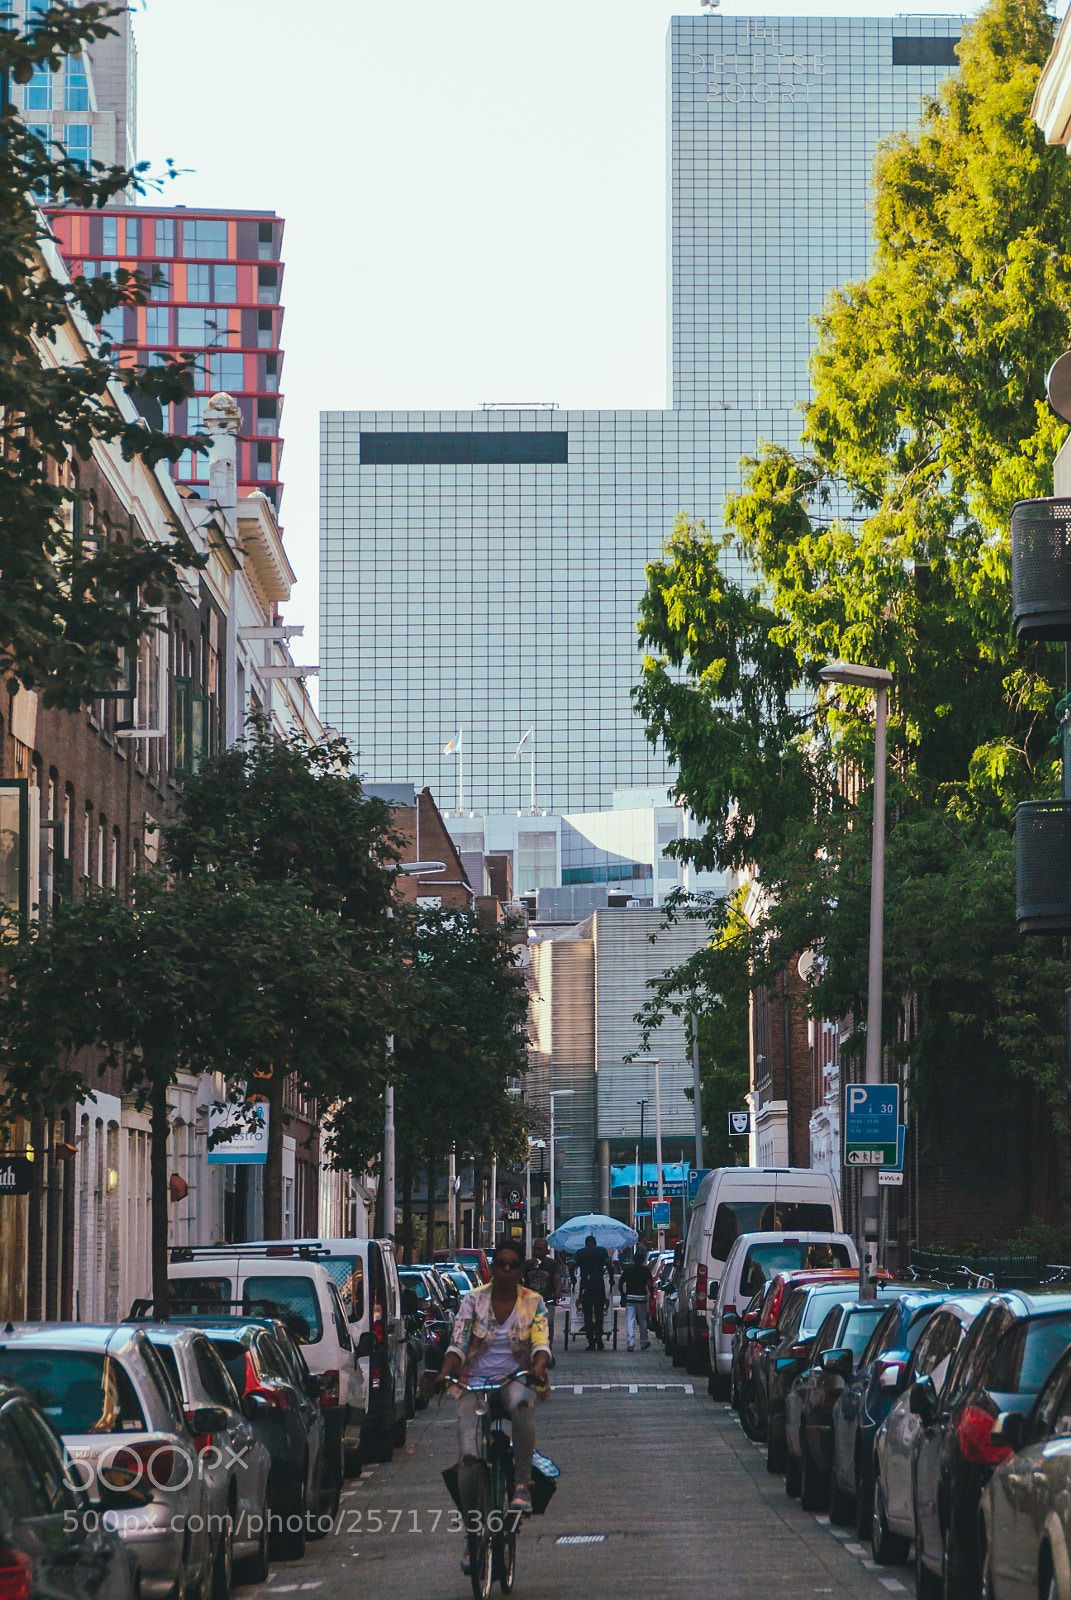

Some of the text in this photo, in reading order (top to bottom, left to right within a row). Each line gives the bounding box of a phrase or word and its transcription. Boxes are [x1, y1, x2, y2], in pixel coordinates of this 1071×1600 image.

[688, 53, 827, 75] DELFTSE
[706, 81, 815, 104] POORT
[850, 1088, 868, 1113] P
[880, 1104, 893, 1113] 30
[232, 1131, 263, 1141] estro
[690, 1172, 698, 1183] P
